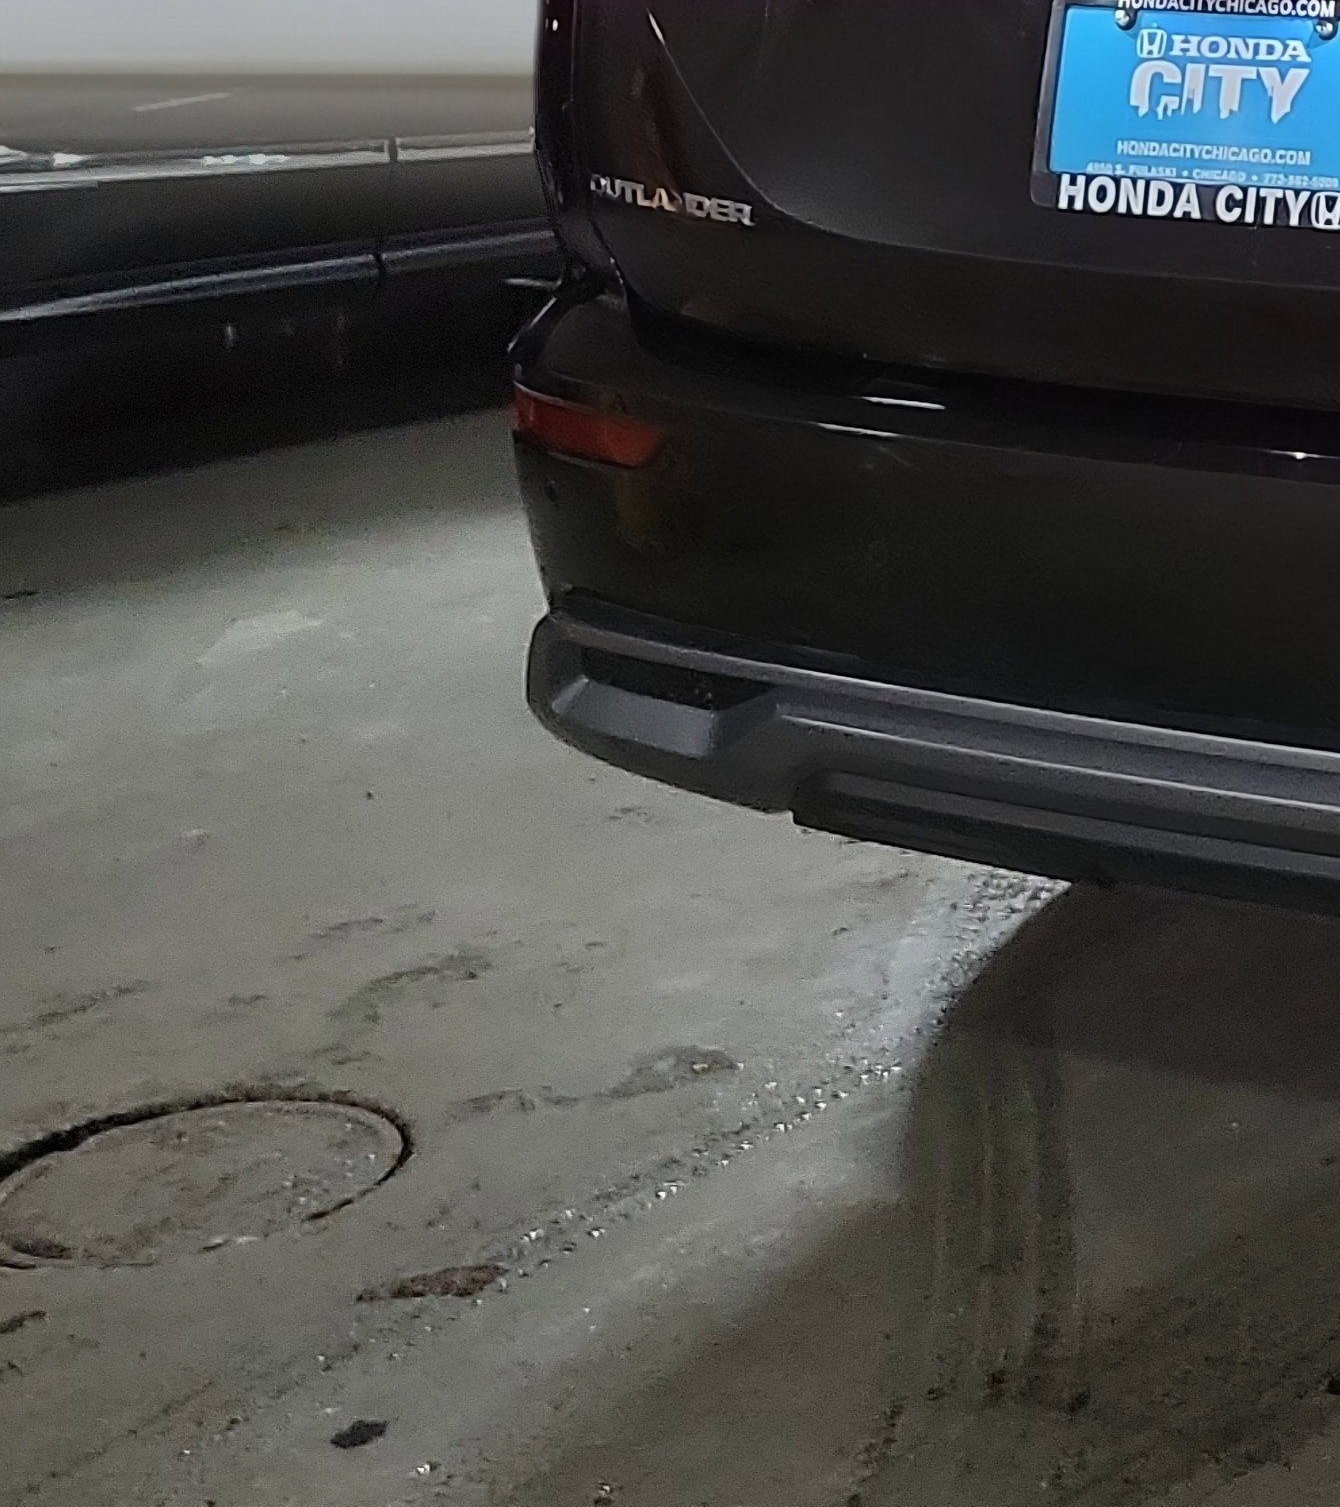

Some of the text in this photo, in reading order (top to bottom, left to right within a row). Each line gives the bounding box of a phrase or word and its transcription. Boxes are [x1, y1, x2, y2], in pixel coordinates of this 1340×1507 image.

[1170, 35, 1312, 63] HONDA
[1129, 60, 1310, 124] CITY
[1116, 140, 1311, 166] HONDACITYCHICAGO.COM
[1058, 174, 1201, 220] HONDA
[1215, 184, 1312, 228] CITY
